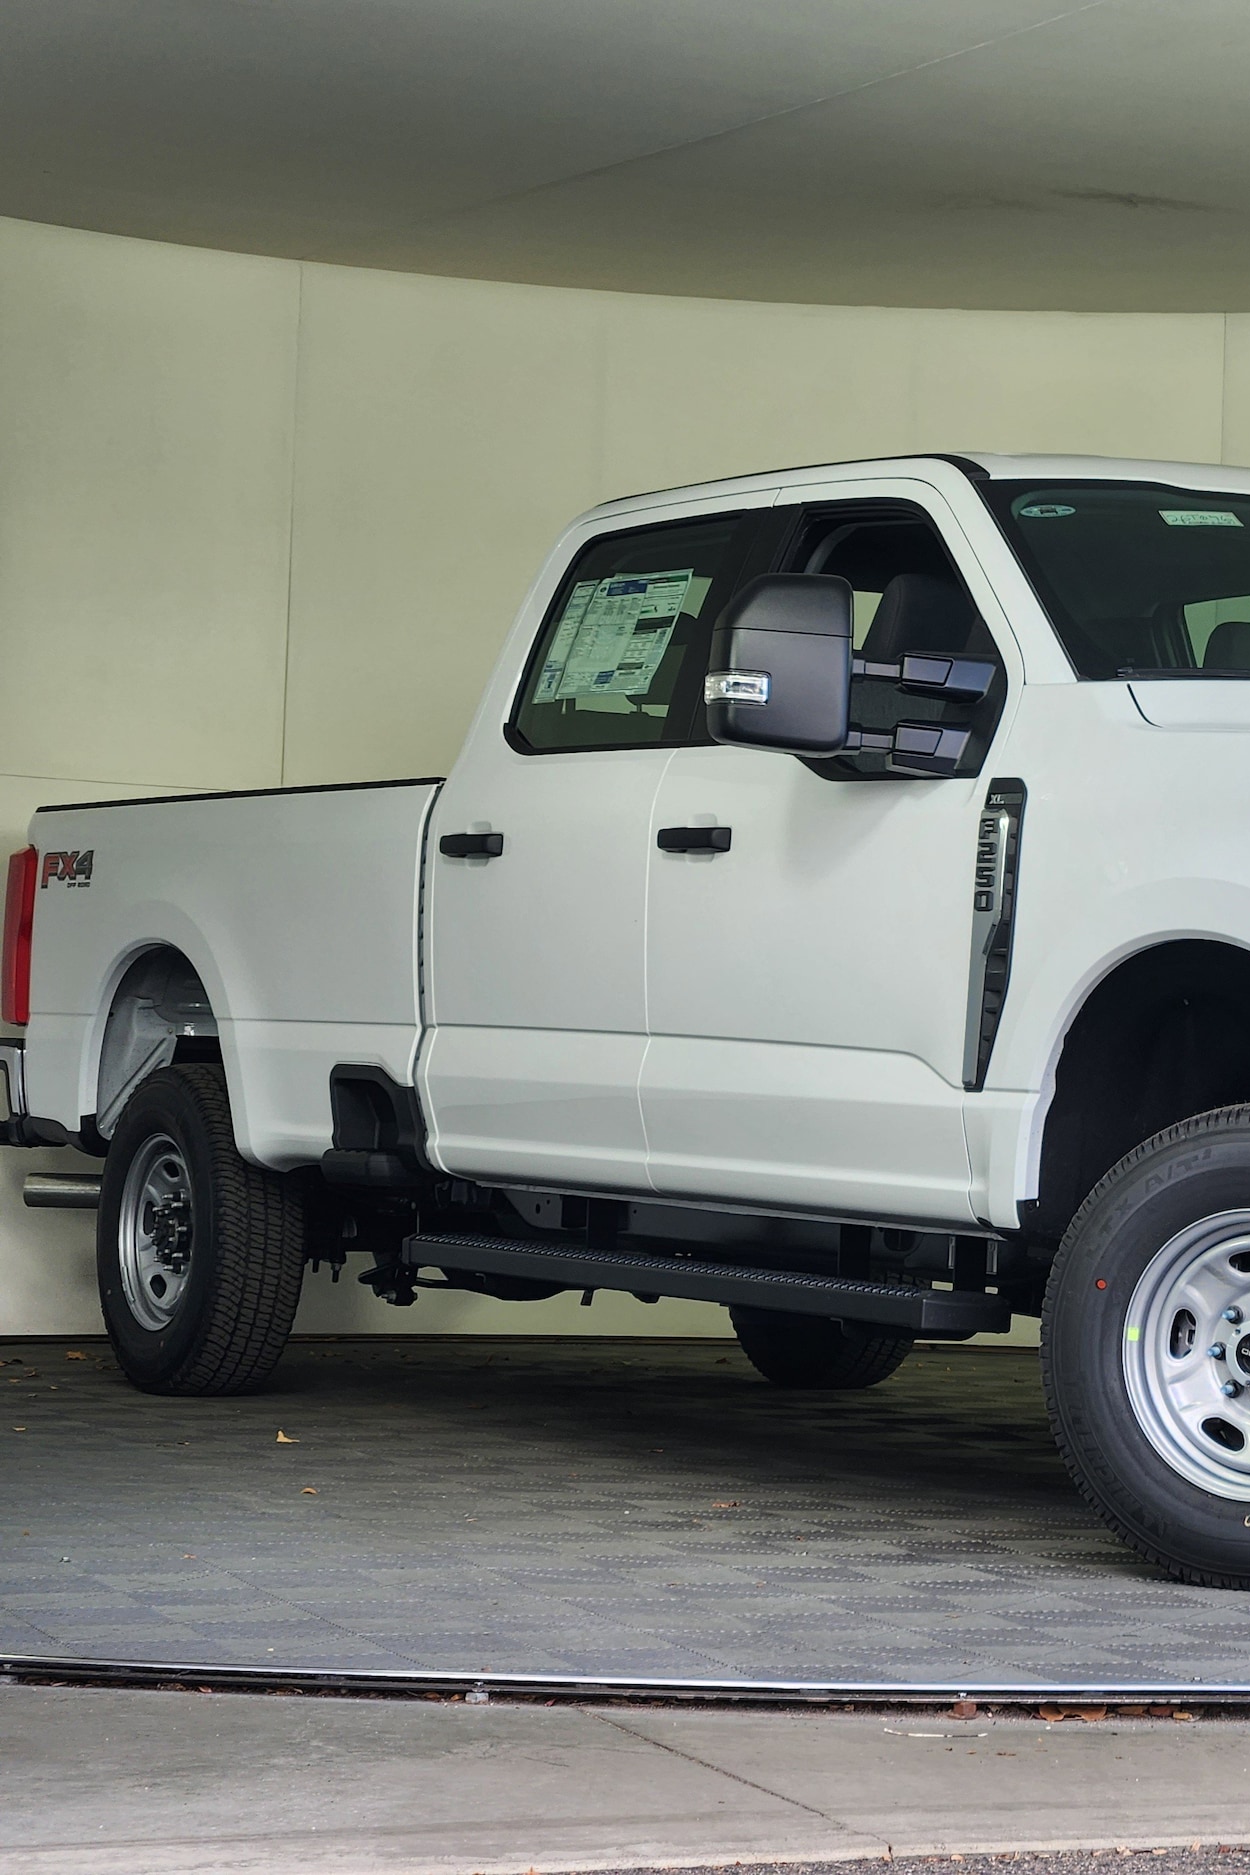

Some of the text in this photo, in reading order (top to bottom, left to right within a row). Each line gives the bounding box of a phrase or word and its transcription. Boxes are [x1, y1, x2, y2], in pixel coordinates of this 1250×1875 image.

[989, 794, 1004, 805] XL
[41, 850, 94, 889] FX4
[974, 819, 998, 912] F250
